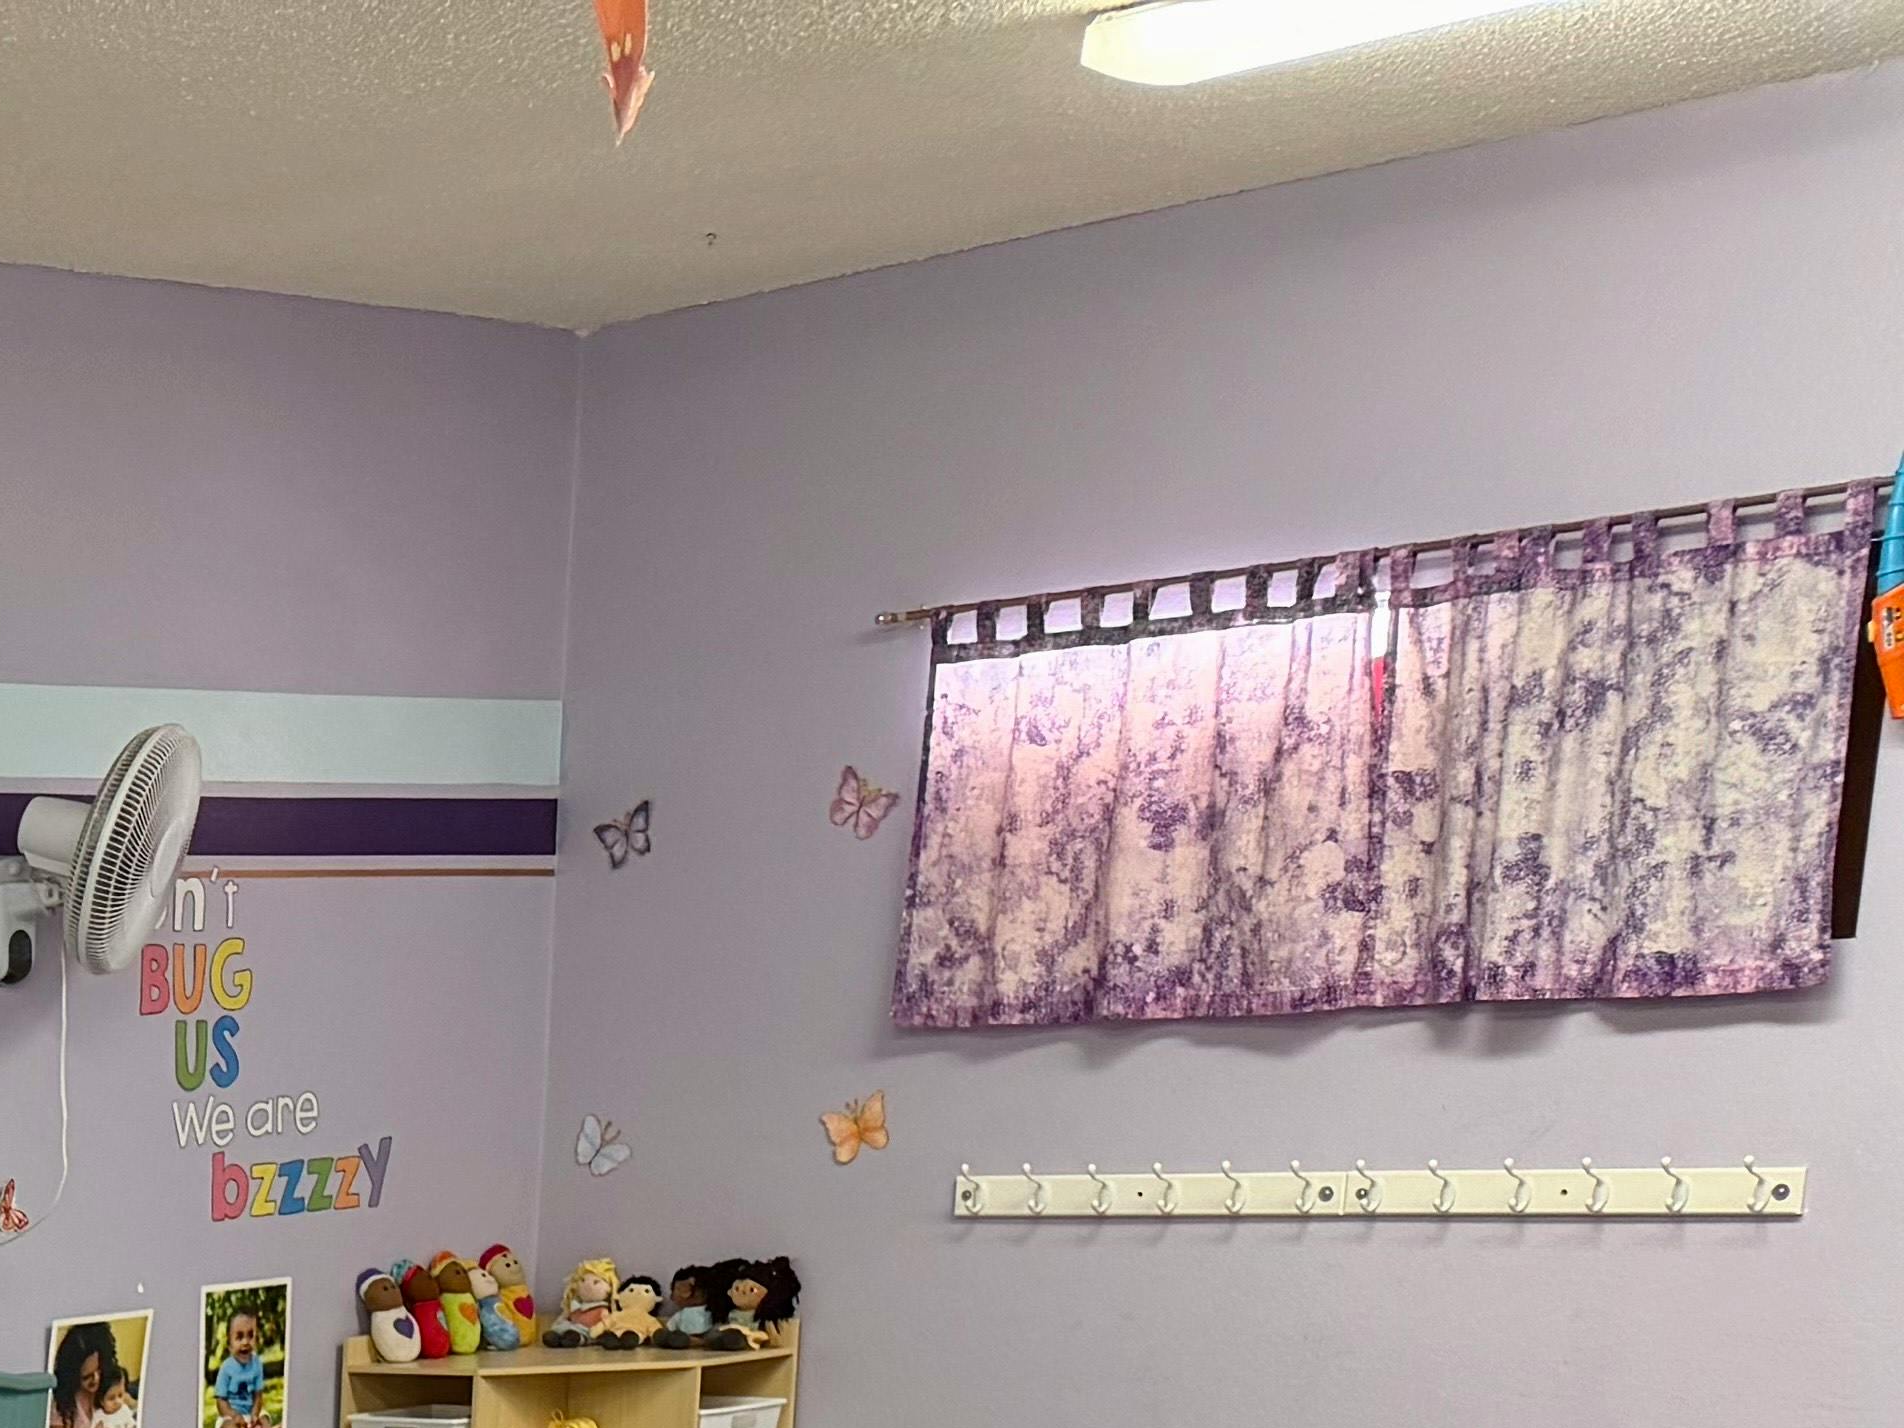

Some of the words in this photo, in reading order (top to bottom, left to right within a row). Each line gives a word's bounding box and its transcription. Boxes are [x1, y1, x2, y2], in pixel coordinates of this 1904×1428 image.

[139, 936, 253, 1015] BUG
[174, 1015, 240, 1092] US
[171, 1096, 235, 1149] We
[245, 1092, 319, 1138] are
